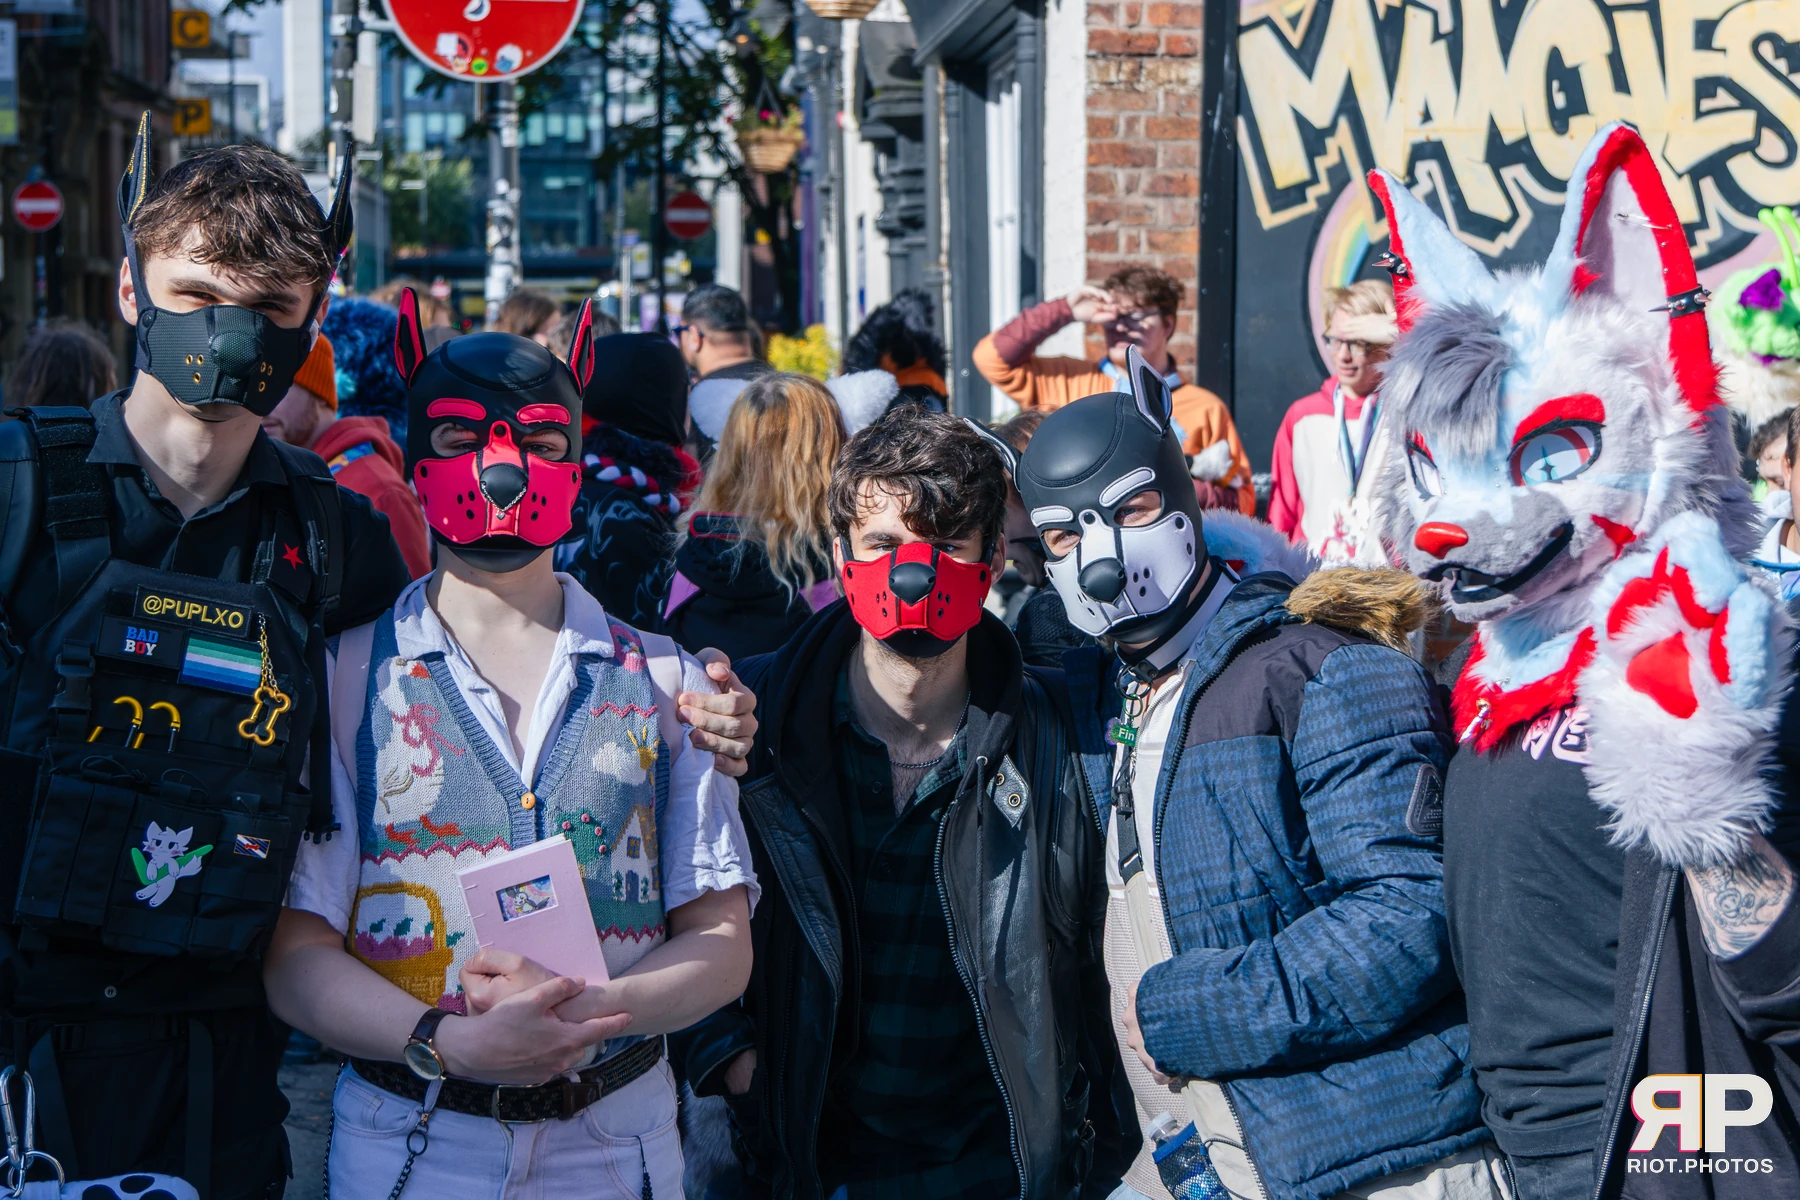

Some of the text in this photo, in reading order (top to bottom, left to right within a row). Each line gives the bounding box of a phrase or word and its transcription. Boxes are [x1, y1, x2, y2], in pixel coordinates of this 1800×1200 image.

[180, 103, 204, 128] P
[143, 595, 244, 629] @PUPLXO
[126, 626, 159, 644] BAD
[124, 639, 157, 656] BOY
[1118, 727, 1135, 742] Fin
